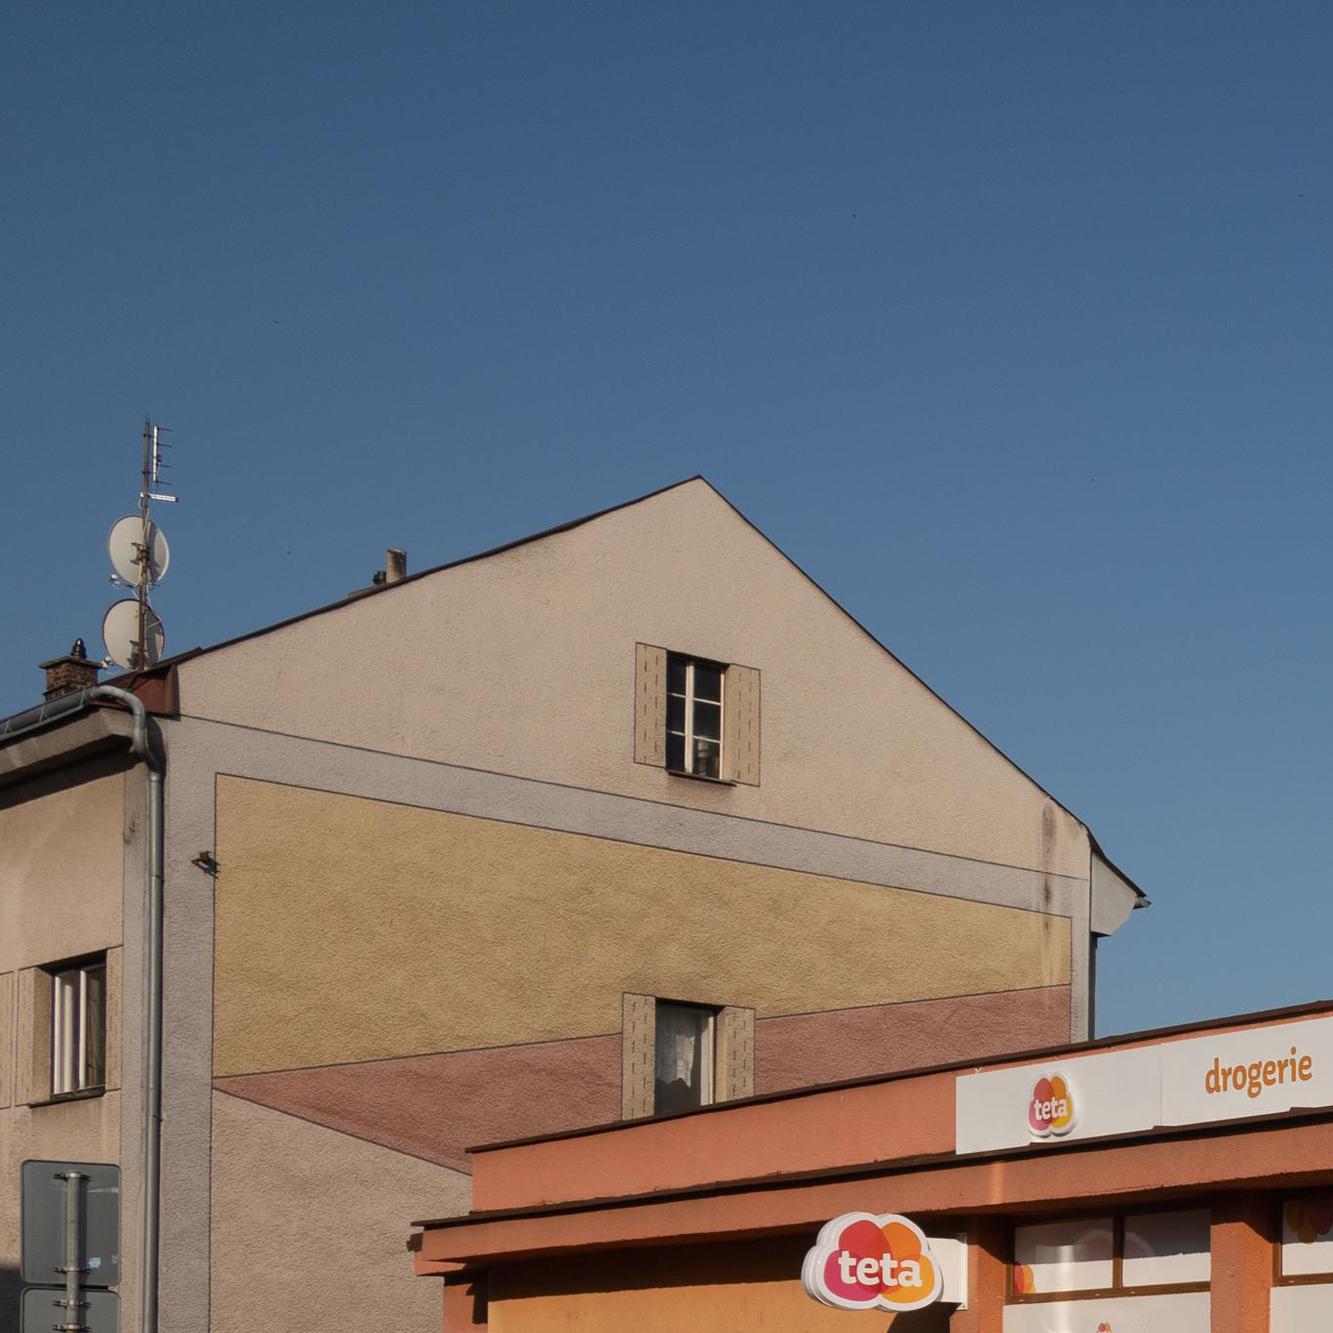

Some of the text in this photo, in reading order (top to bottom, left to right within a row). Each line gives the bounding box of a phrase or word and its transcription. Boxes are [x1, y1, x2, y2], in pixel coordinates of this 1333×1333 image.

[1204, 1046, 1313, 1099] drogerie
[1033, 1096, 1068, 1121] teta
[837, 1250, 923, 1288] teta
